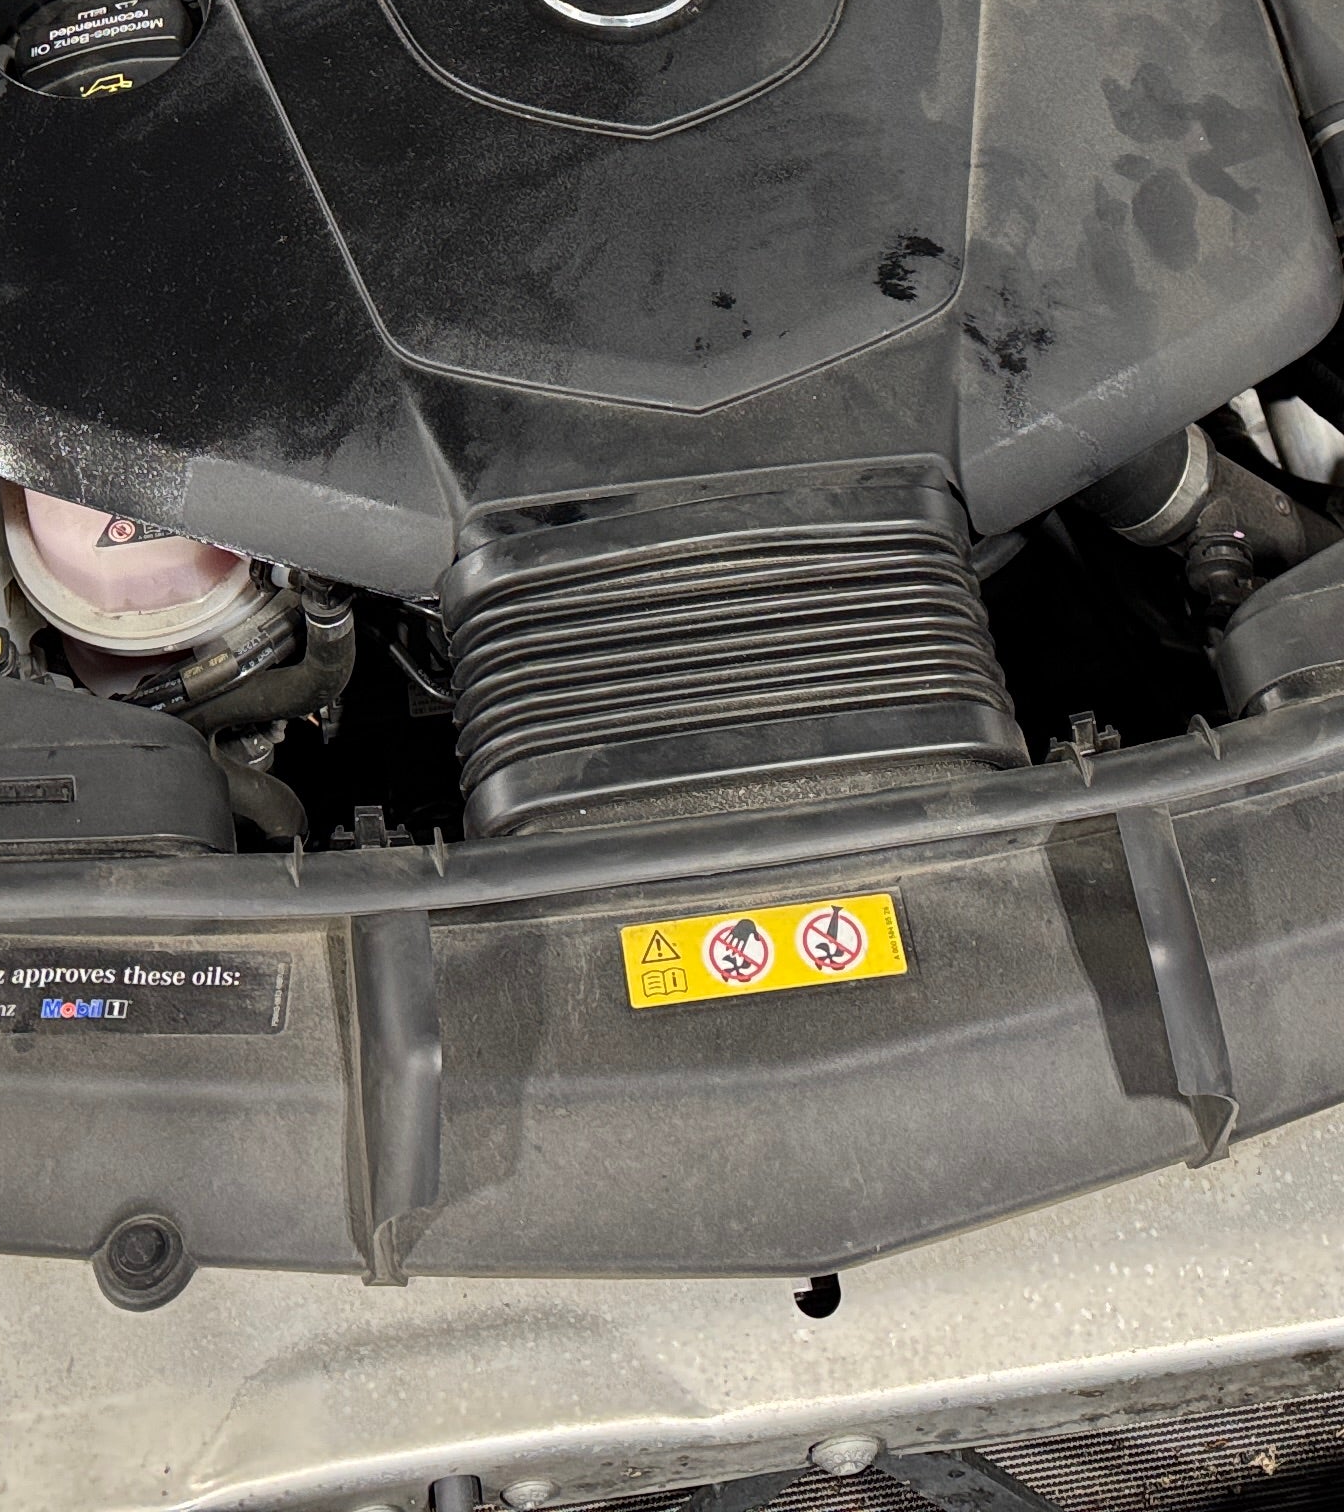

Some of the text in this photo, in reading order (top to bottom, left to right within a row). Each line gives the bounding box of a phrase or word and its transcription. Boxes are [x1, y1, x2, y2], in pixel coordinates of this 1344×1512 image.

[30, 18, 164, 58] Mercedes-Benz Oil
[49, 9, 149, 40] recommended
[11, 965, 116, 988] approves
[123, 966, 185, 986] these
[191, 967, 241, 987] oils:
[41, 999, 124, 1019] Mobil 1
